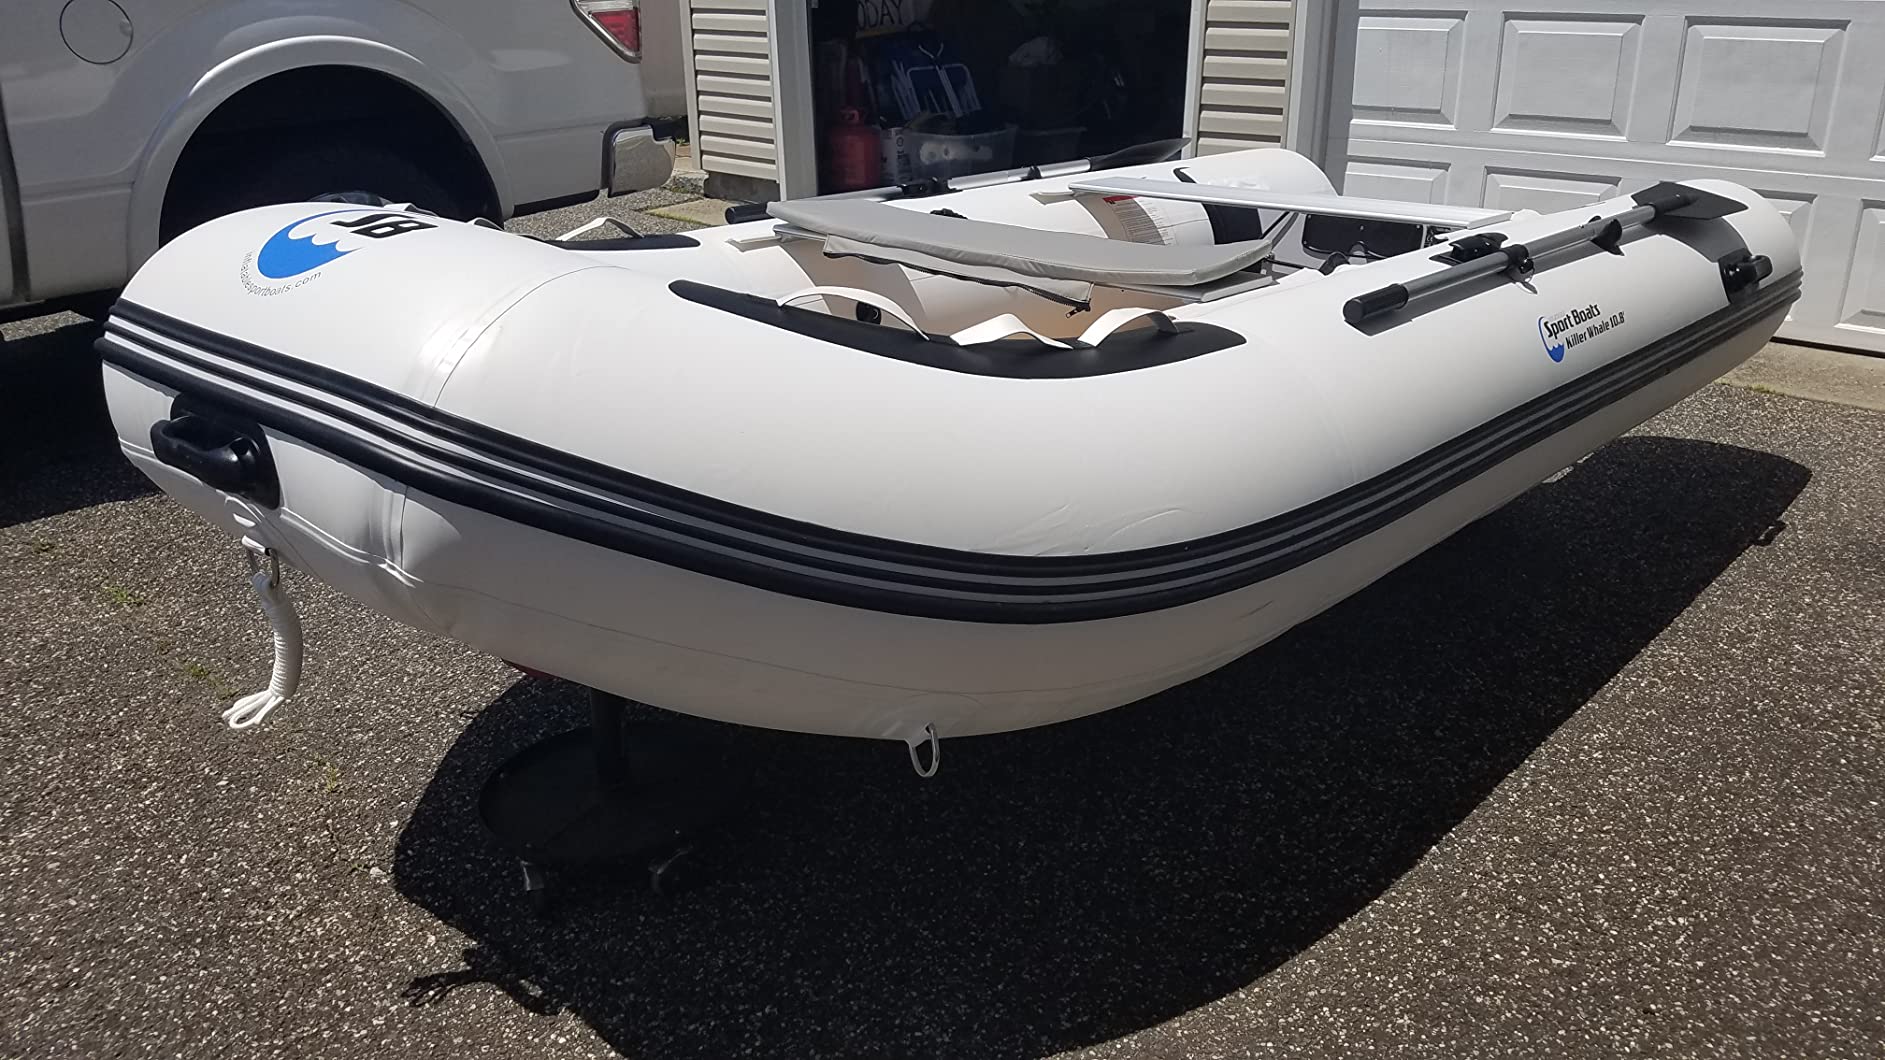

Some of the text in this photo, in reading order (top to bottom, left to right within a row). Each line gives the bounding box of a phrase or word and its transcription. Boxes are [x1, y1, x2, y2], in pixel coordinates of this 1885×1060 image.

[1543, 313, 1575, 340] Sport
[1570, 303, 1601, 326] Boats
[1565, 330, 1588, 350] Killer
[1586, 320, 1610, 339] Whale
